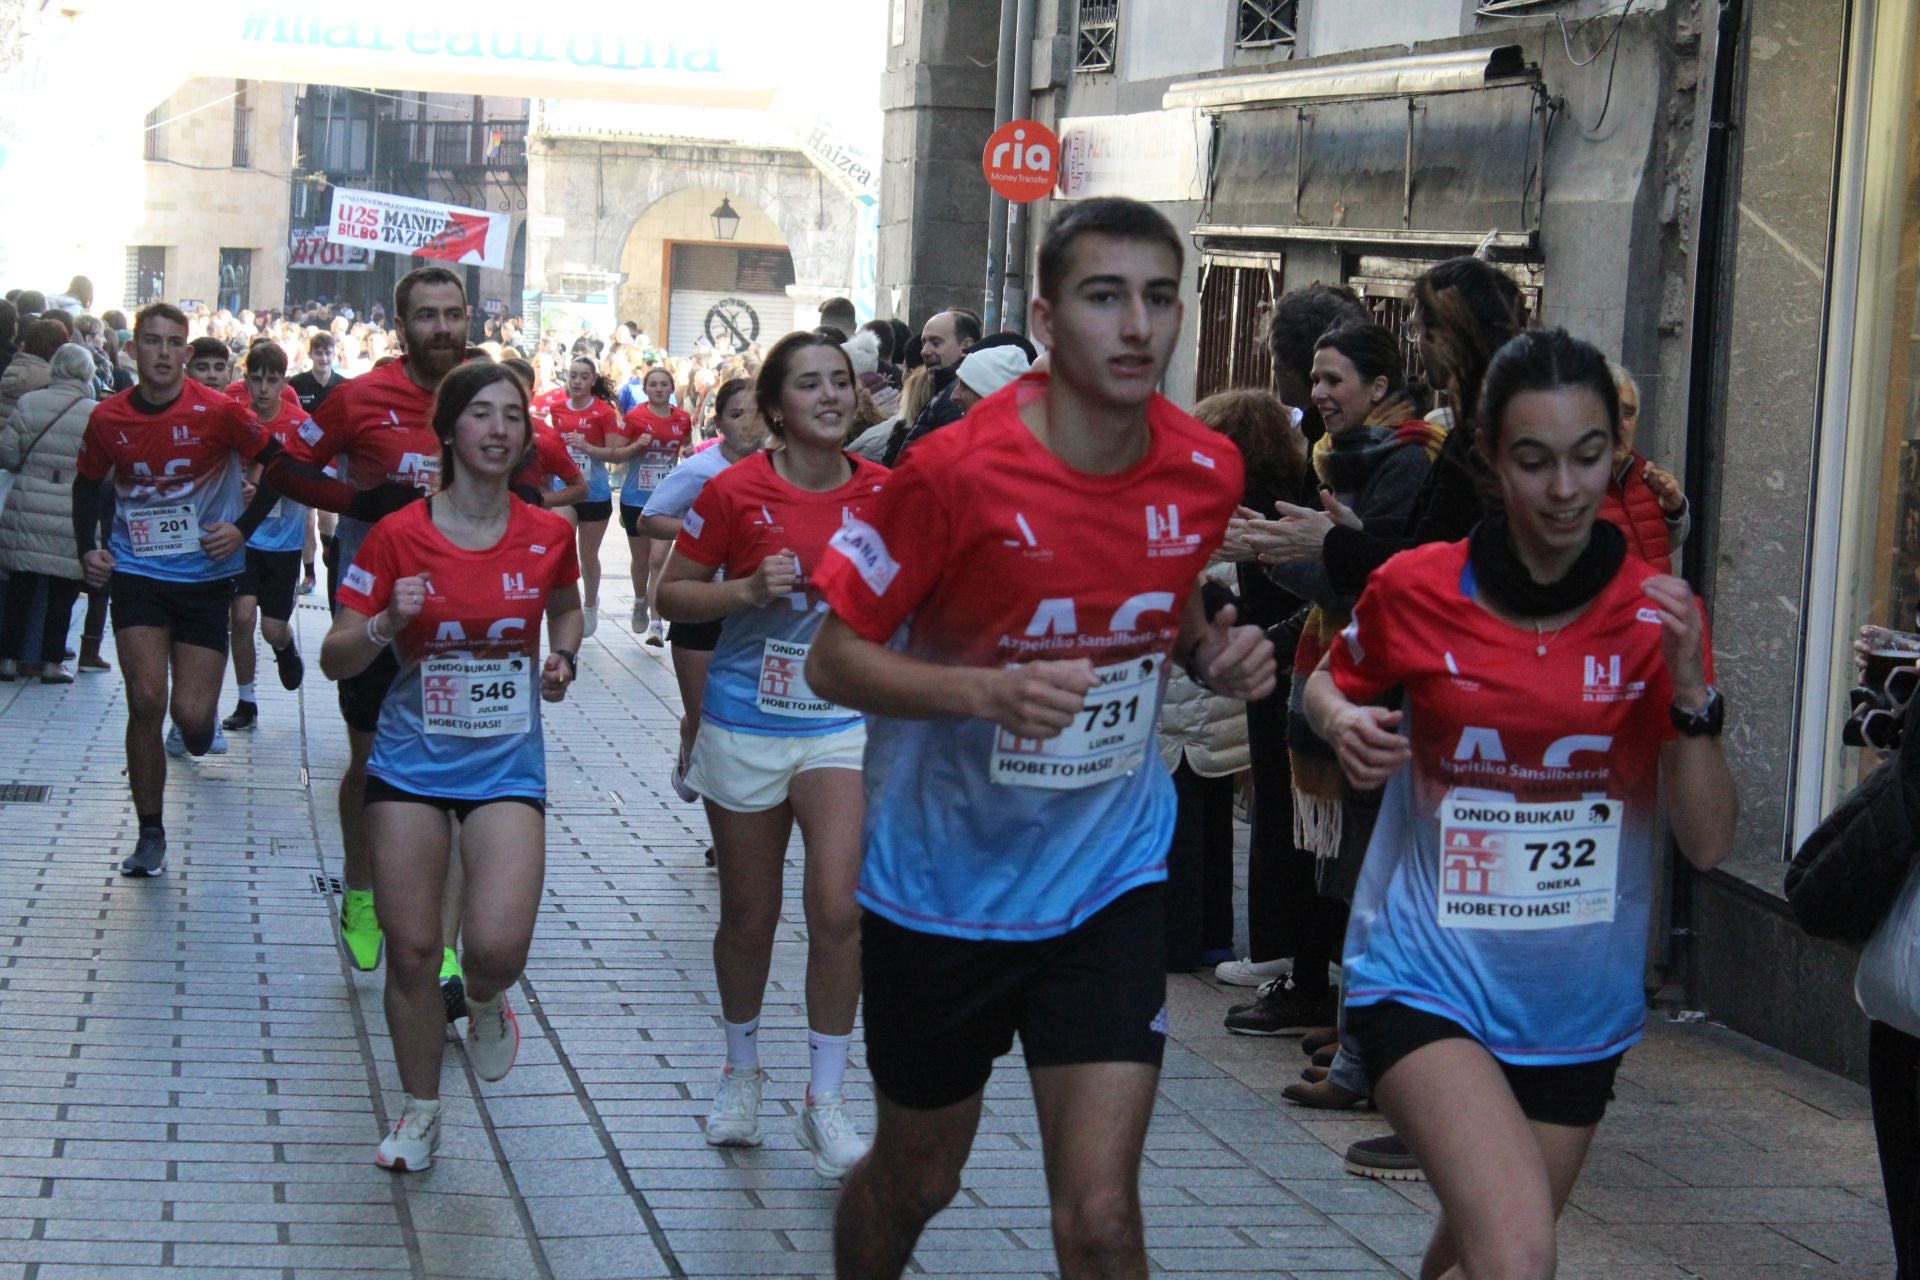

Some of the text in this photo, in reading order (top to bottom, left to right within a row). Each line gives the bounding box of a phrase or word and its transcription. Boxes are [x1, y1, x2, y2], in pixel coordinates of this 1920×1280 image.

[805, 127, 871, 187] Haizea
[992, 129, 1050, 171] ria
[991, 172, 1048, 184] Money Transfer
[337, 222, 378, 241] BILBO
[159, 519, 189, 533] 201
[771, 644, 805, 656] ONDO
[428, 663, 501, 673] ONDO BUKAU
[470, 681, 516, 702] 546
[477, 705, 509, 714] JULENE
[761, 697, 834, 711] HOBETO HASI!
[1083, 696, 1139, 732] 731
[428, 718, 472, 730] HOBETO
[473, 720, 502, 730] HASI!
[1088, 734, 1124, 750] LUKEN
[999, 759, 1074, 776] HOBETO
[1077, 757, 1113, 775] HASI!
[1454, 808, 1575, 824] ONDO BUKAU
[1524, 838, 1596, 872] 732
[1537, 878, 1581, 891] ONEKA
[1447, 901, 1523, 917] HOBETO
[1528, 902, 1571, 917] HASI!
